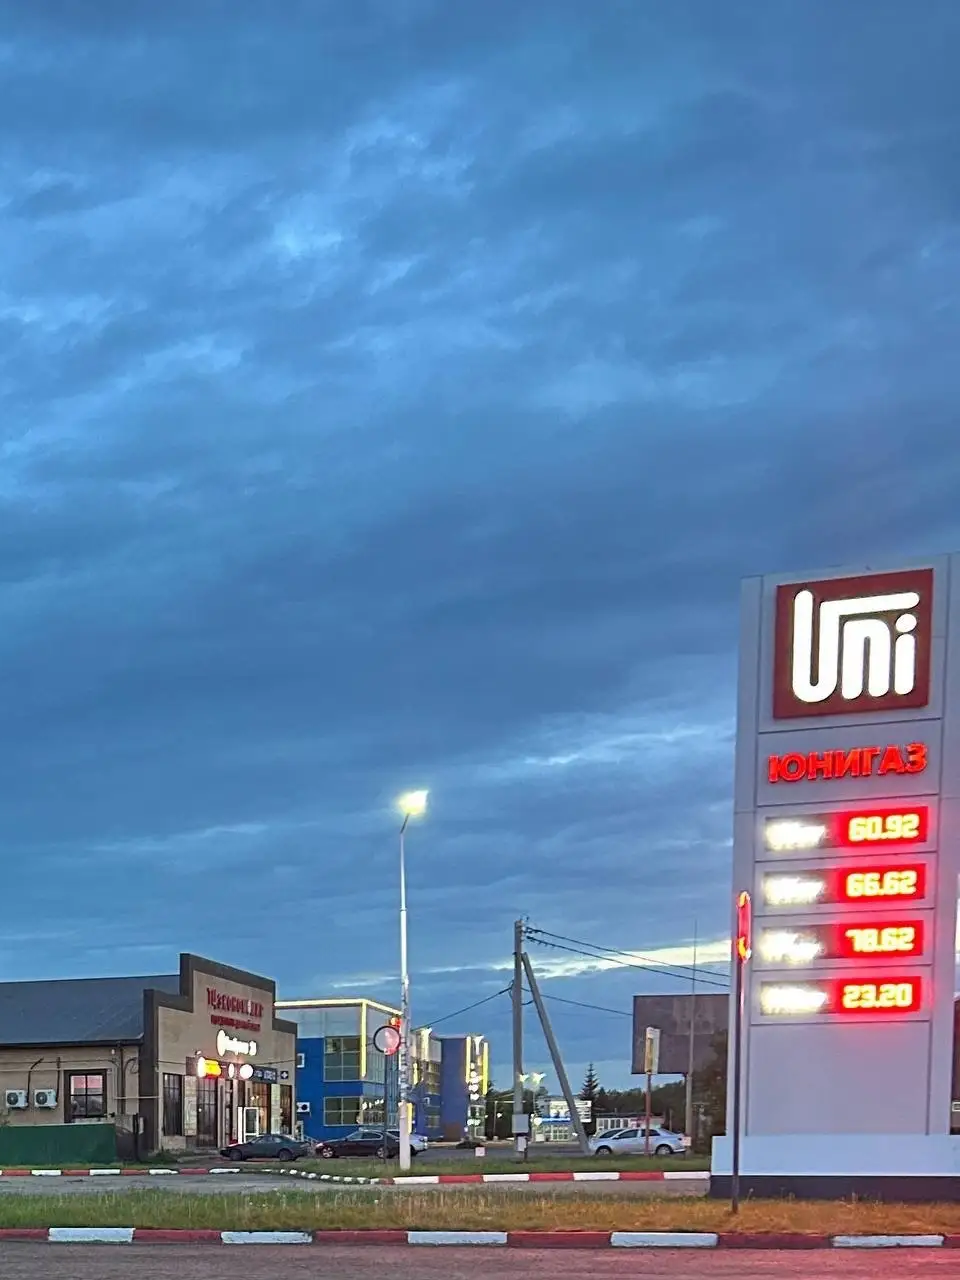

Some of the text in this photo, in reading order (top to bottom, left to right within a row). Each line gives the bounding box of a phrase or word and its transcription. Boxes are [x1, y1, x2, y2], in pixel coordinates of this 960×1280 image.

[768, 743, 928, 784] ЮНИГАЗ
[848, 813, 920, 842] 60.92
[842, 983, 913, 1009] 23.20
